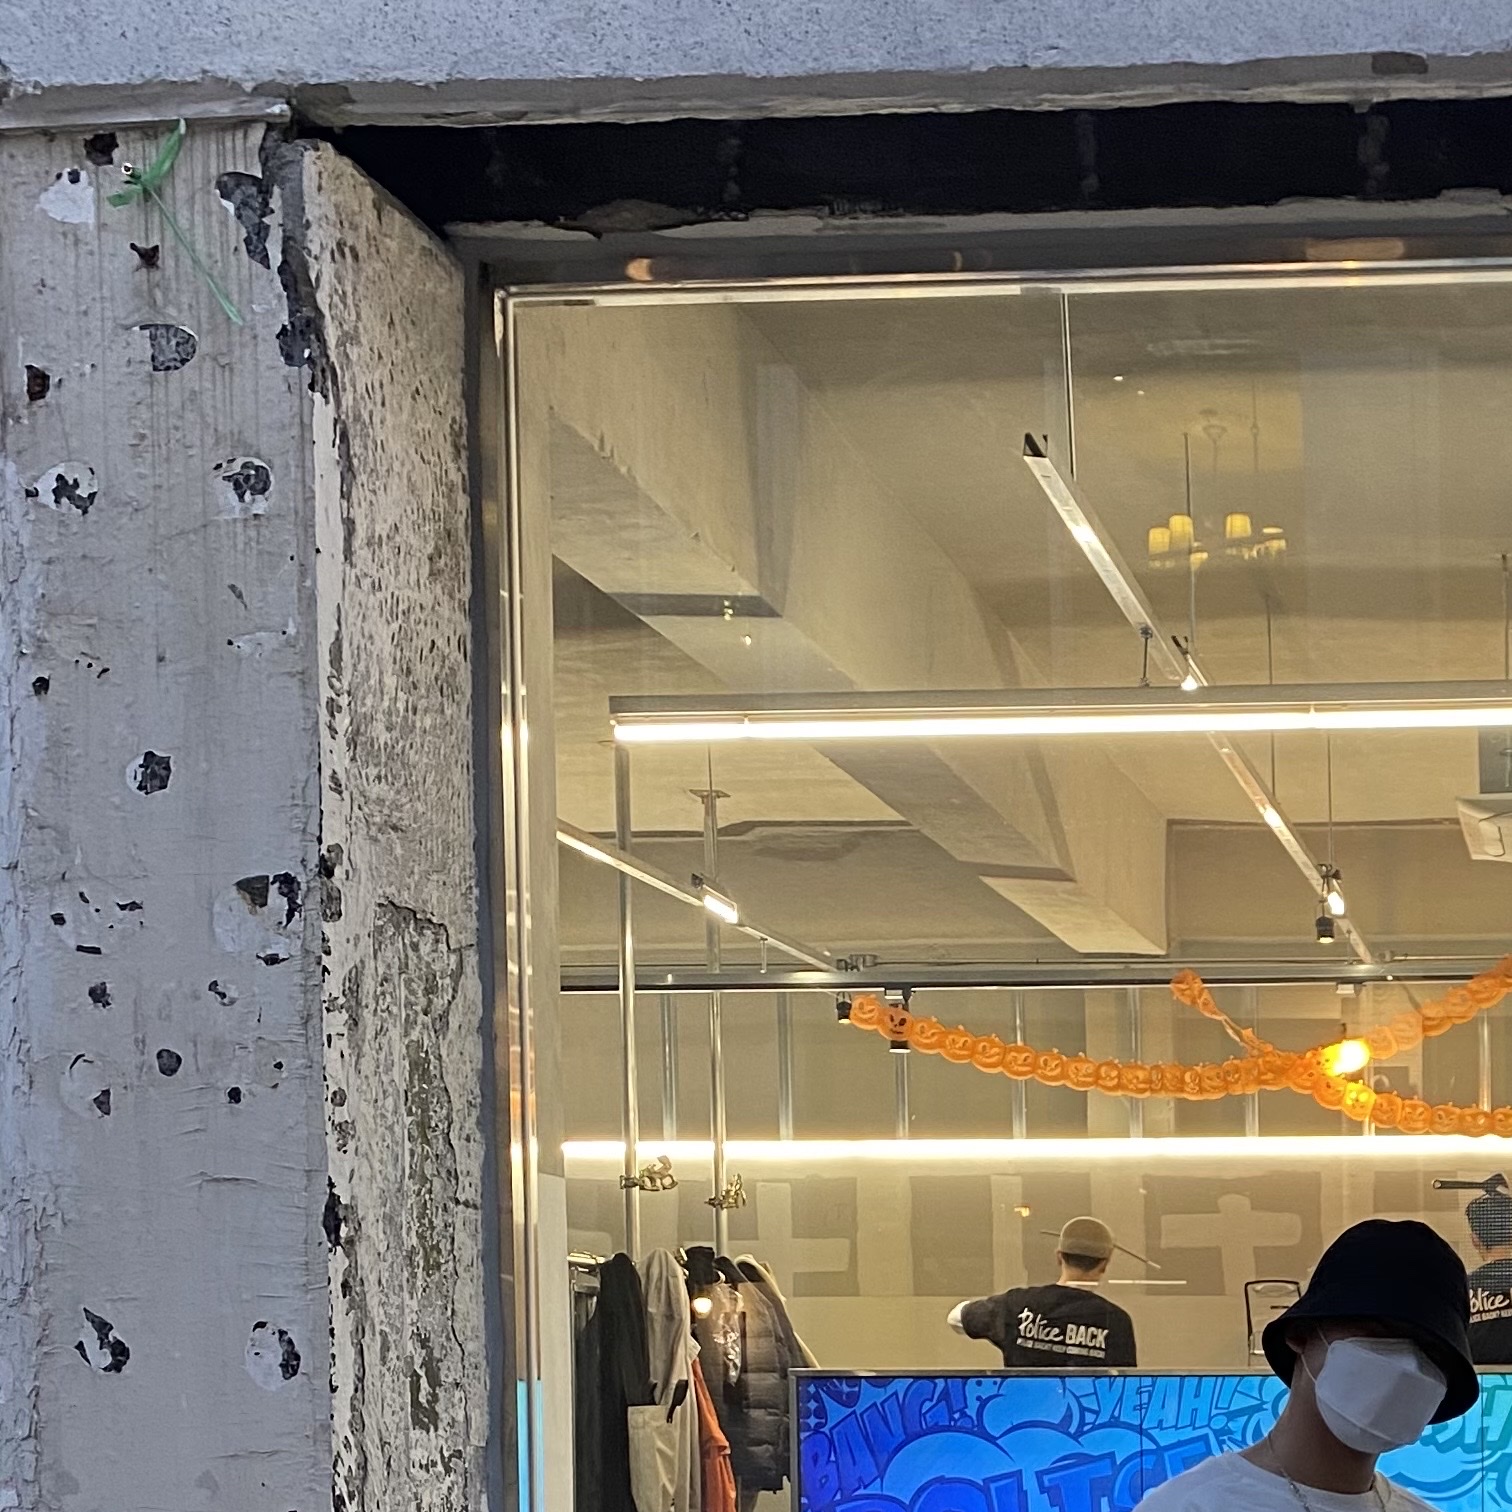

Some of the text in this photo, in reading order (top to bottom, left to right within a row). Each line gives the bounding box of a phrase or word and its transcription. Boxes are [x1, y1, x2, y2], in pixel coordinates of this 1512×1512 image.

[1017, 1307, 1064, 1341] Police
[1065, 1323, 1109, 1349] BACK
[1094, 1377, 1243, 1430] YEAH!
